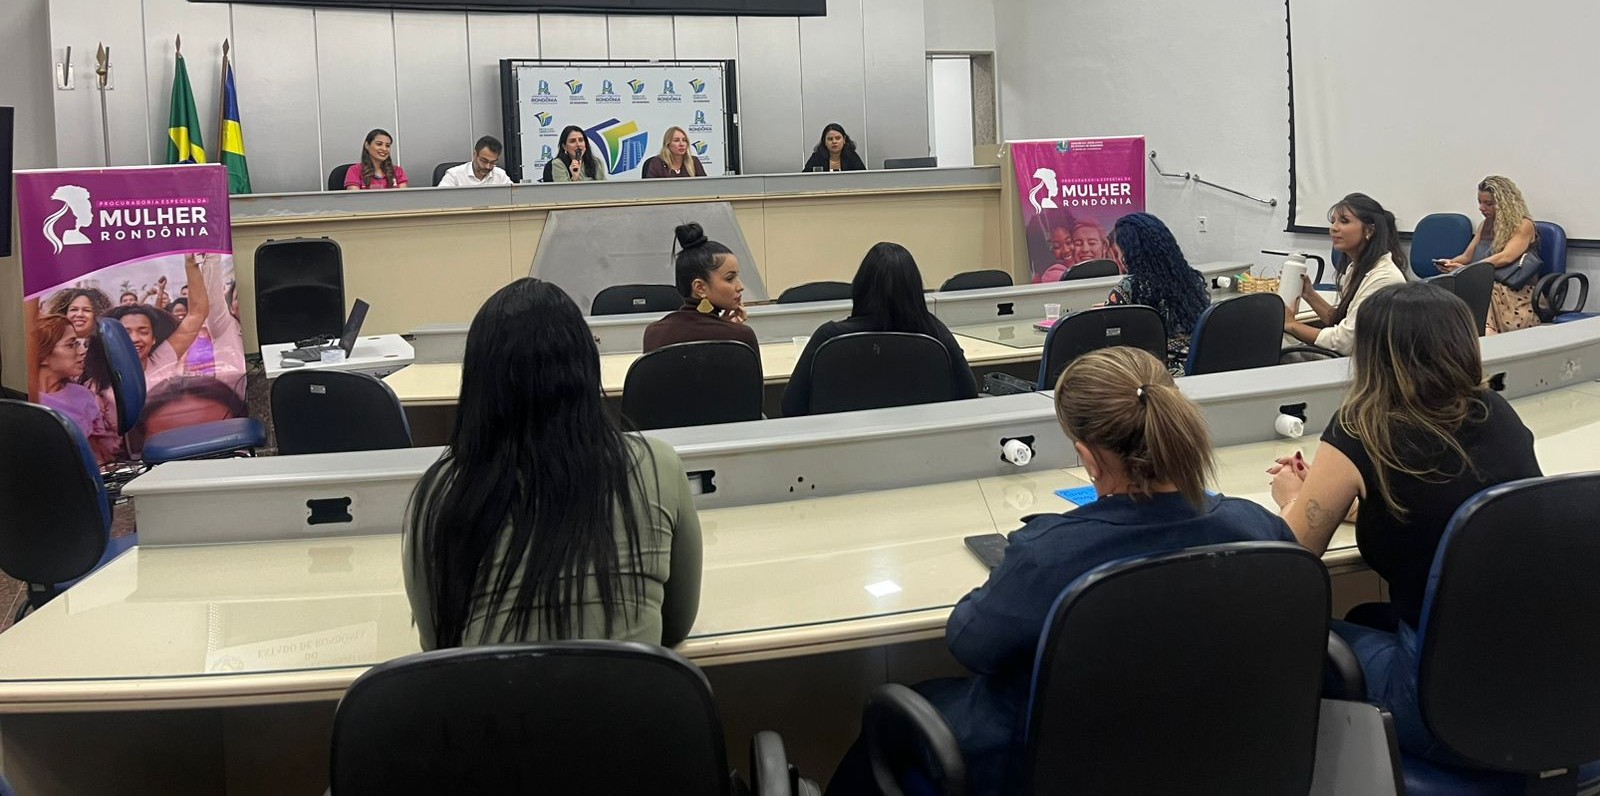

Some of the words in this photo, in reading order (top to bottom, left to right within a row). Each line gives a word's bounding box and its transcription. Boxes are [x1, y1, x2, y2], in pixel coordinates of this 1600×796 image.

[1062, 183, 1131, 197] MULHER
[1063, 197, 1132, 206] RONDÔNIA
[100, 207, 208, 228] MULHER
[100, 226, 209, 241] RONDÔNIA
